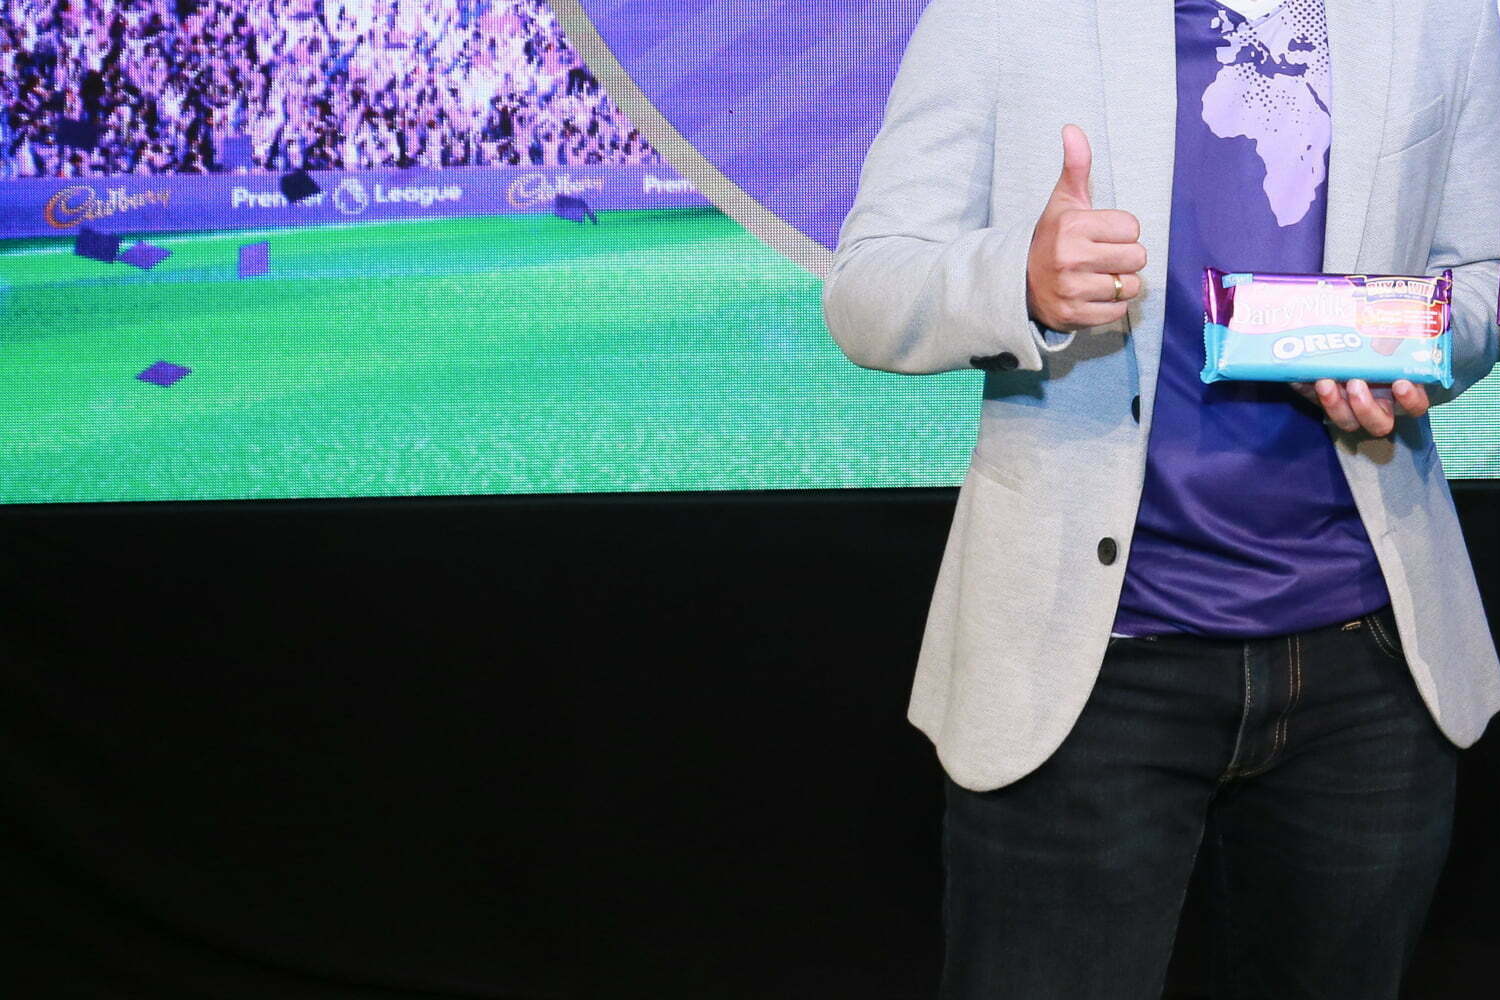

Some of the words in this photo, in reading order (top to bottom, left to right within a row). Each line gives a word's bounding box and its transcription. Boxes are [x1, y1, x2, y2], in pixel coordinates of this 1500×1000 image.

[44, 184, 170, 230] Cadbury
[375, 183, 463, 206] League
[1273, 332, 1362, 360] OREO
